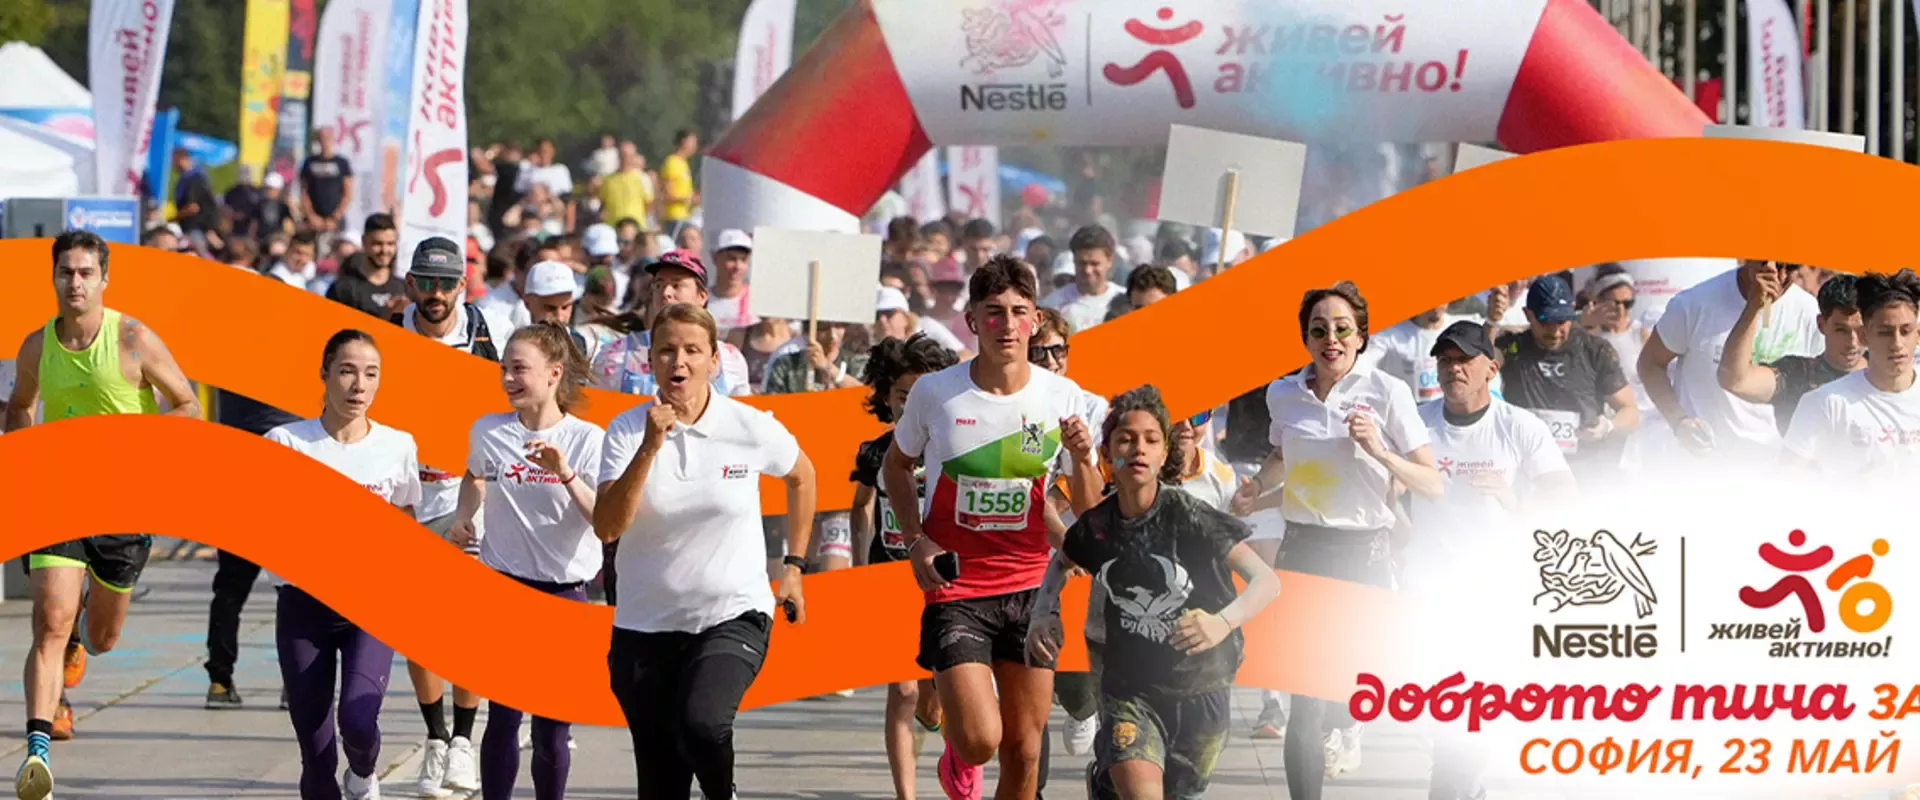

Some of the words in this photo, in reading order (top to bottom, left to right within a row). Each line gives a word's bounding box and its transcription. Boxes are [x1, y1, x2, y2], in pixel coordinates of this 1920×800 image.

[1215, 13, 1407, 55] живей
[1212, 48, 1469, 94] акивно!
[1551, 421, 1574, 439] 23
[965, 491, 1026, 513] 1558
